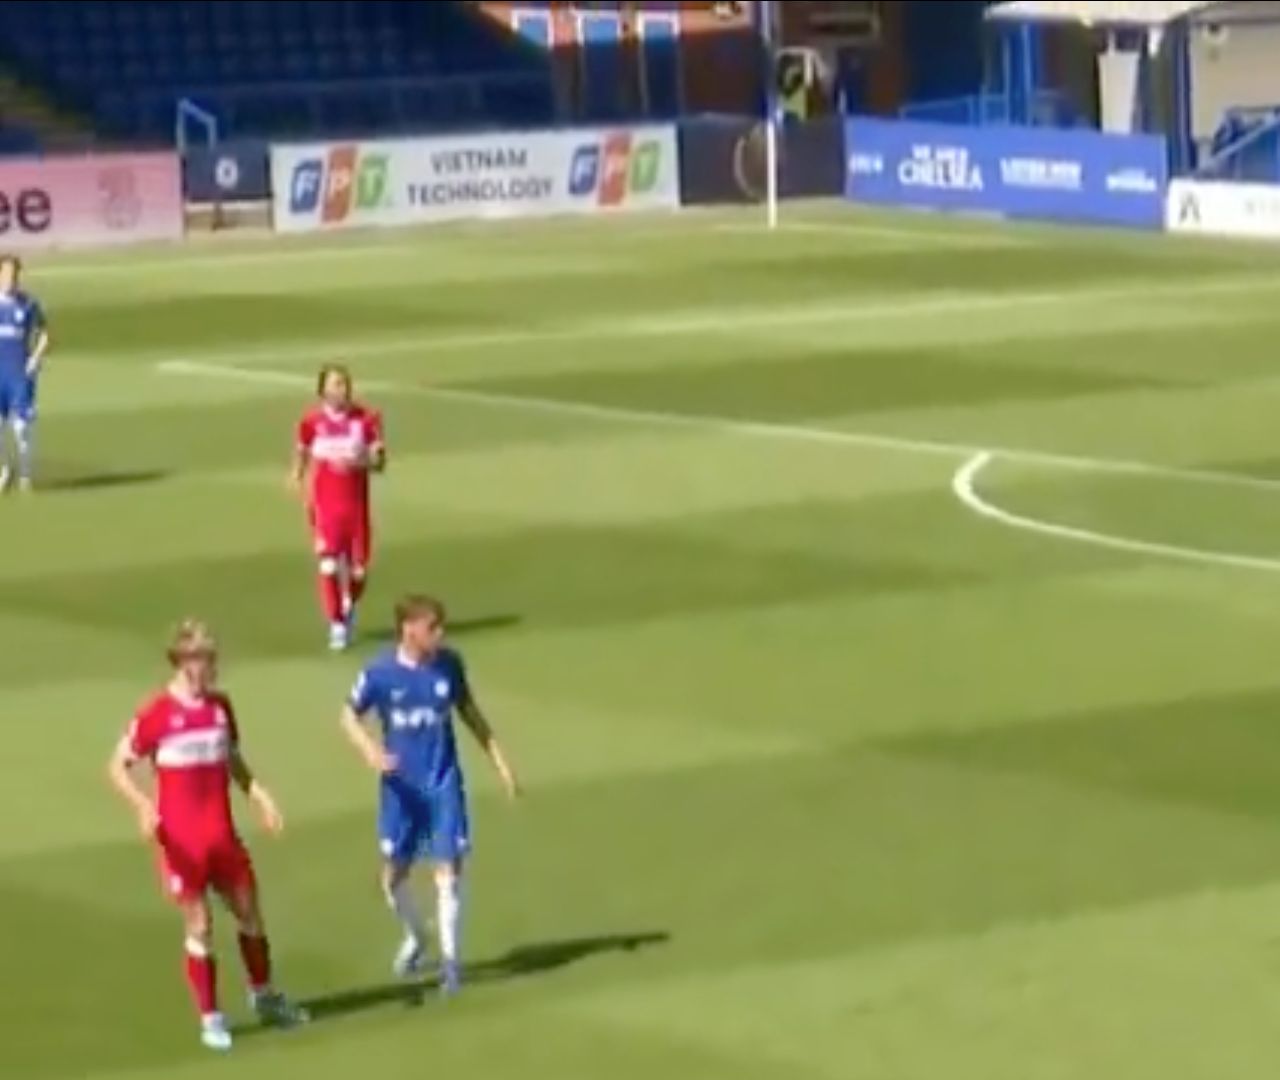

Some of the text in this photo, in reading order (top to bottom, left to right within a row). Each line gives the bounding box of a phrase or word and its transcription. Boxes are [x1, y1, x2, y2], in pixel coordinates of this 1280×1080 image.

[430, 149, 527, 174] VIETNAM
[291, 149, 387, 215] FPT
[407, 179, 553, 205] TECHNOLOGY
